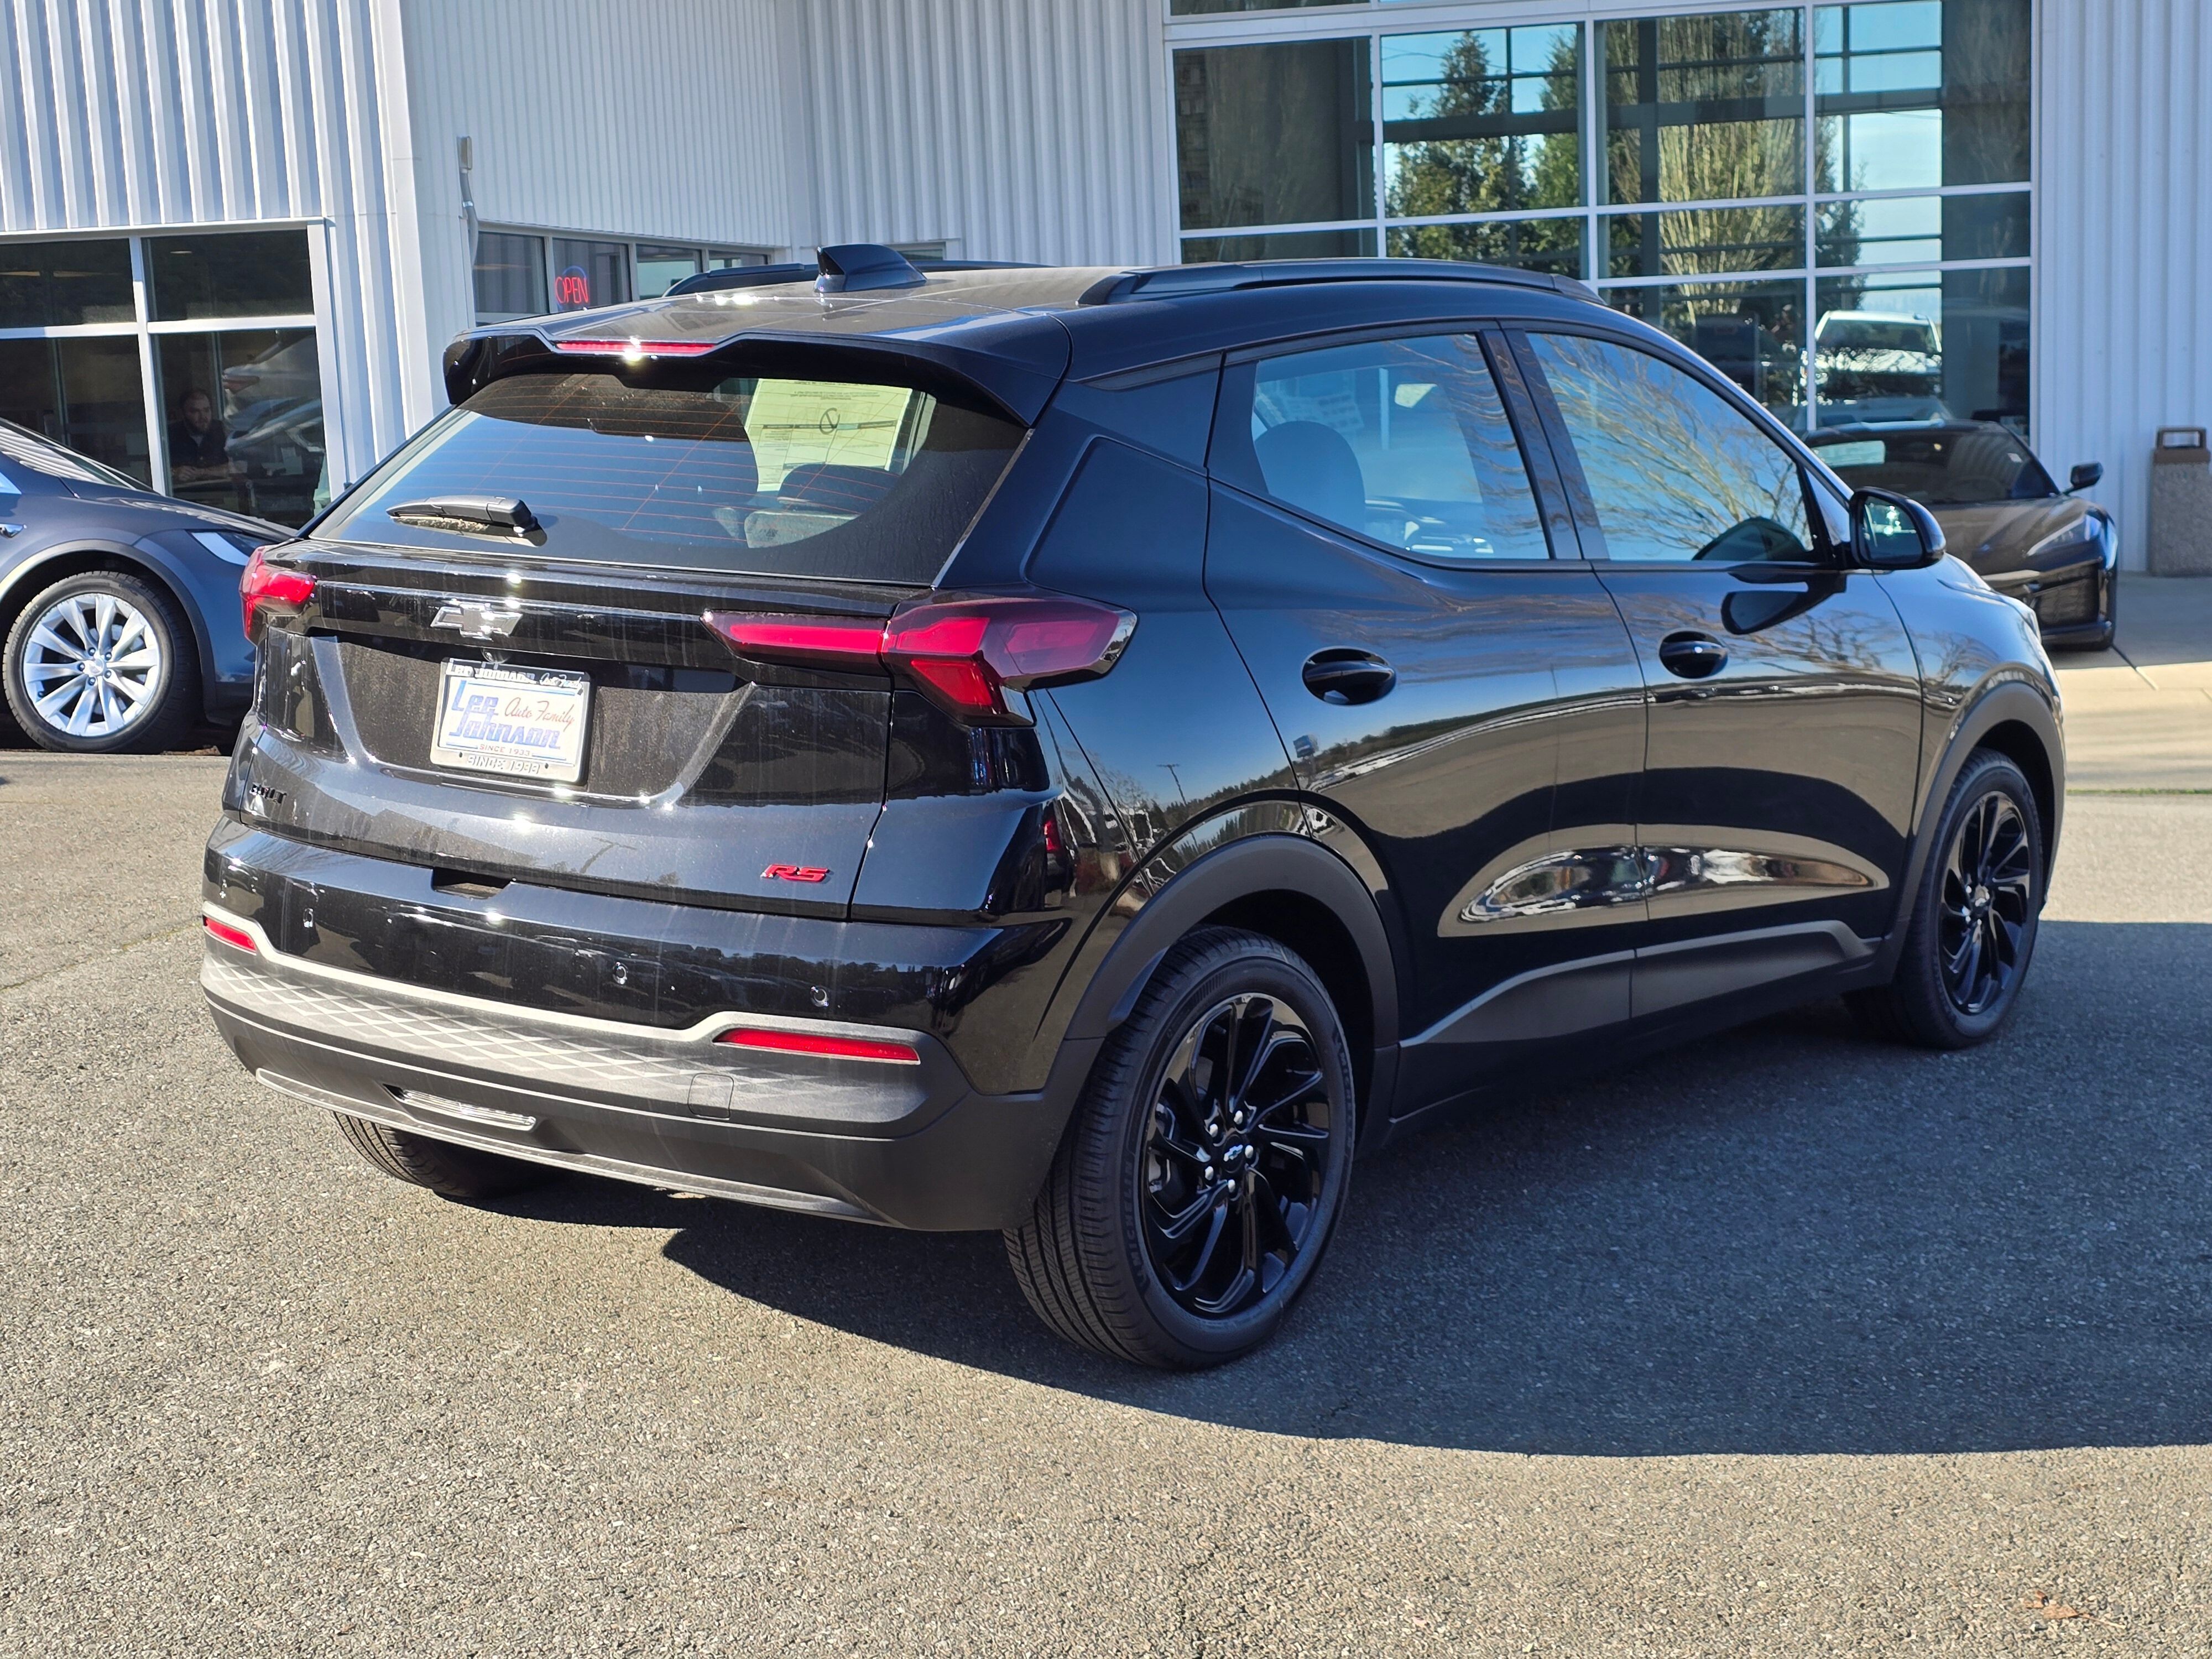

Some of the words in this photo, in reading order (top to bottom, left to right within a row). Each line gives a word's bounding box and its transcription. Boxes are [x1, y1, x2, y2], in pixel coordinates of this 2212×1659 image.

[555, 276, 588, 304] OPEN
[504, 697, 533, 718] Auto
[535, 700, 575, 732] Family
[479, 744, 505, 753] SINCE
[509, 748, 531, 757] 1933
[467, 755, 507, 770] SINCE
[760, 864, 831, 883] RS
[1123, 1161, 1143, 1267] MICHELIN
